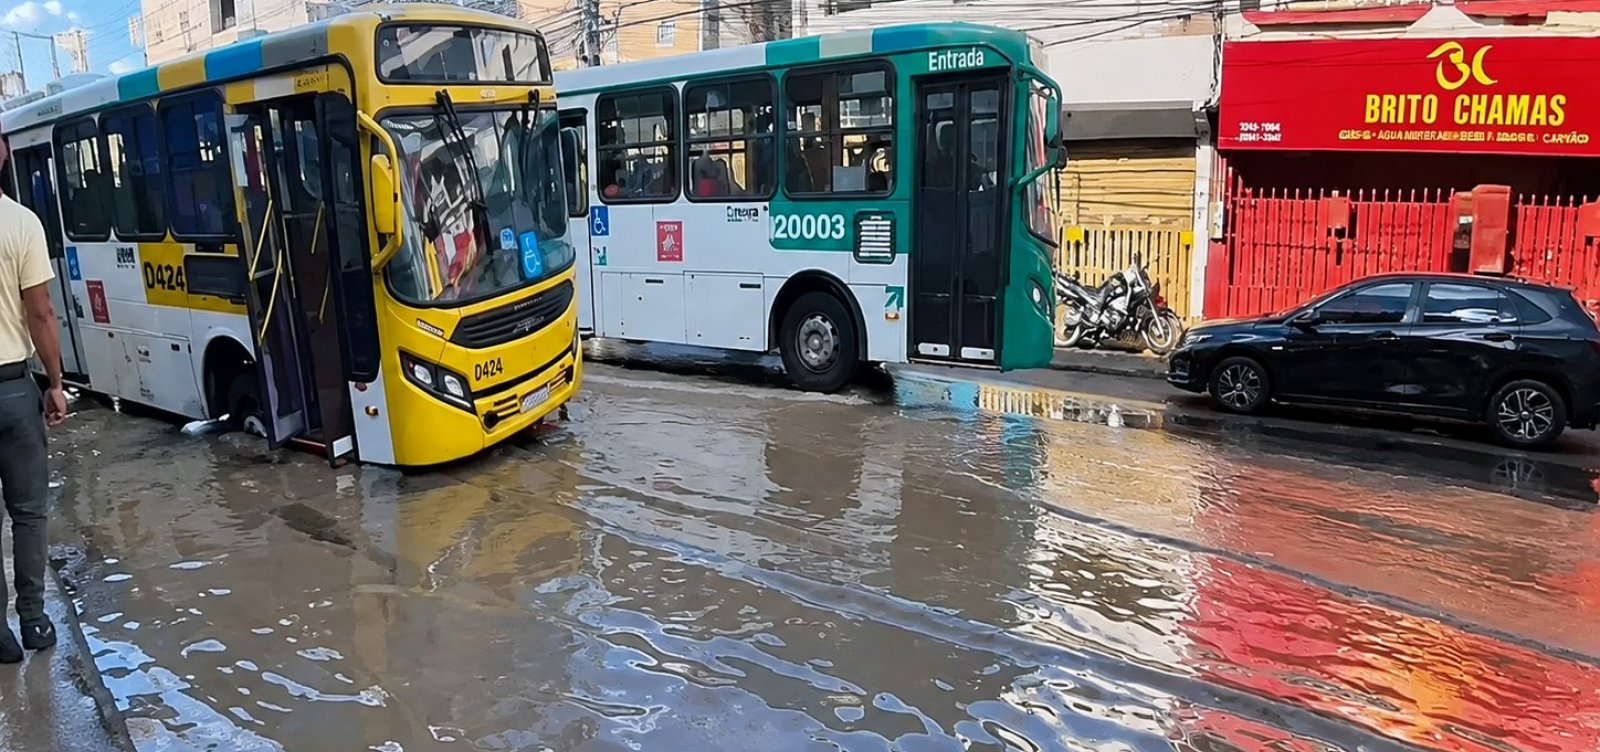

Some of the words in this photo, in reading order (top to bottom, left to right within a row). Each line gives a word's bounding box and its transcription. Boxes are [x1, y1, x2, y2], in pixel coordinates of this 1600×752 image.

[928, 46, 984, 71] Entrada
[1364, 94, 1438, 124] BRITO
[1454, 94, 1567, 126] CHAMAS
[775, 213, 845, 240] 20003
[143, 256, 186, 292] D424
[474, 356, 504, 382] D424
